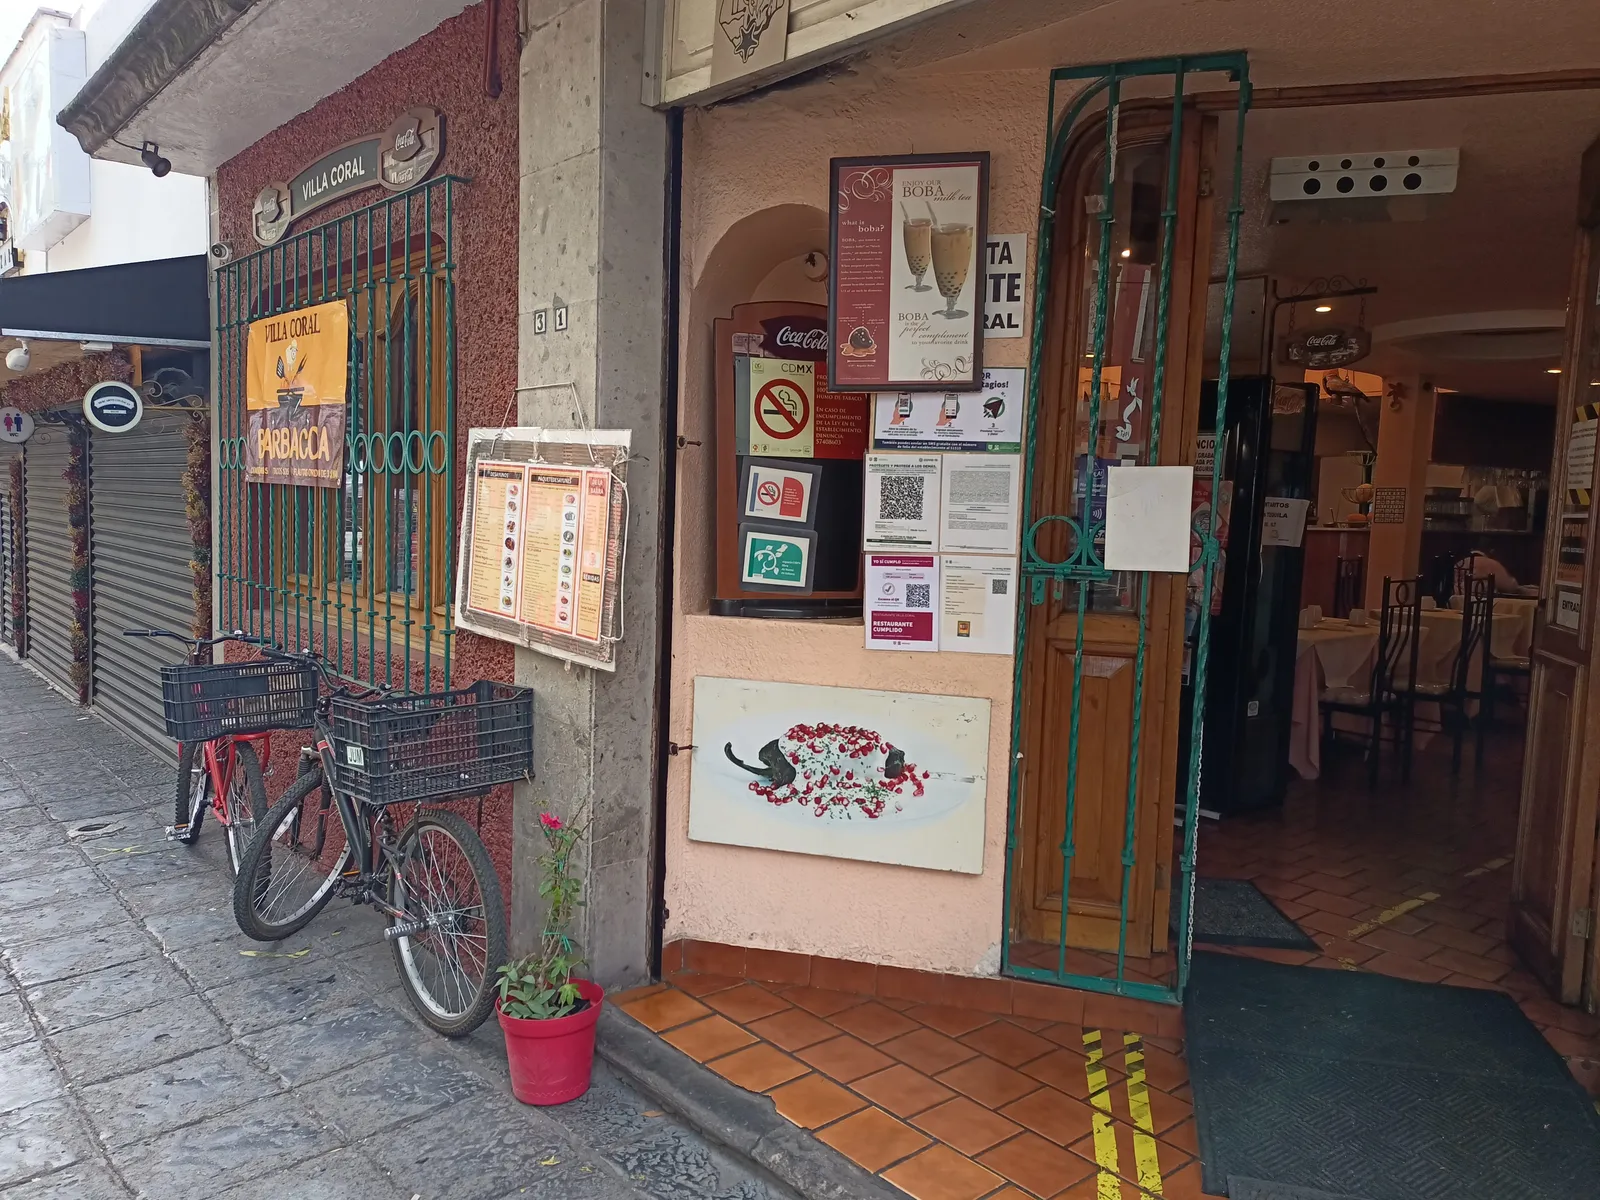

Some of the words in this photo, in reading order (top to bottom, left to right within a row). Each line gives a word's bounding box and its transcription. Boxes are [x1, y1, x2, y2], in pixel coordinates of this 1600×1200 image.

[302, 172, 329, 201] VILLA
[330, 156, 365, 187] CORAL
[902, 185, 945, 198] BOBA
[933, 189, 960, 202] milk
[958, 193, 972, 201] tea
[858, 224, 885, 233] boba?
[986, 241, 1013, 265] TA
[985, 273, 1021, 303] TE
[898, 312, 929, 321] BOBA
[265, 321, 288, 343] VILLA
[290, 313, 321, 338] CORAL
[899, 321, 931, 338] perfect
[918, 330, 969, 344] compliment
[1306, 334, 1339, 347] Coca-Cola
[781, 362, 813, 374] CDMX
[583, 573, 600, 582] BEBIDAS
